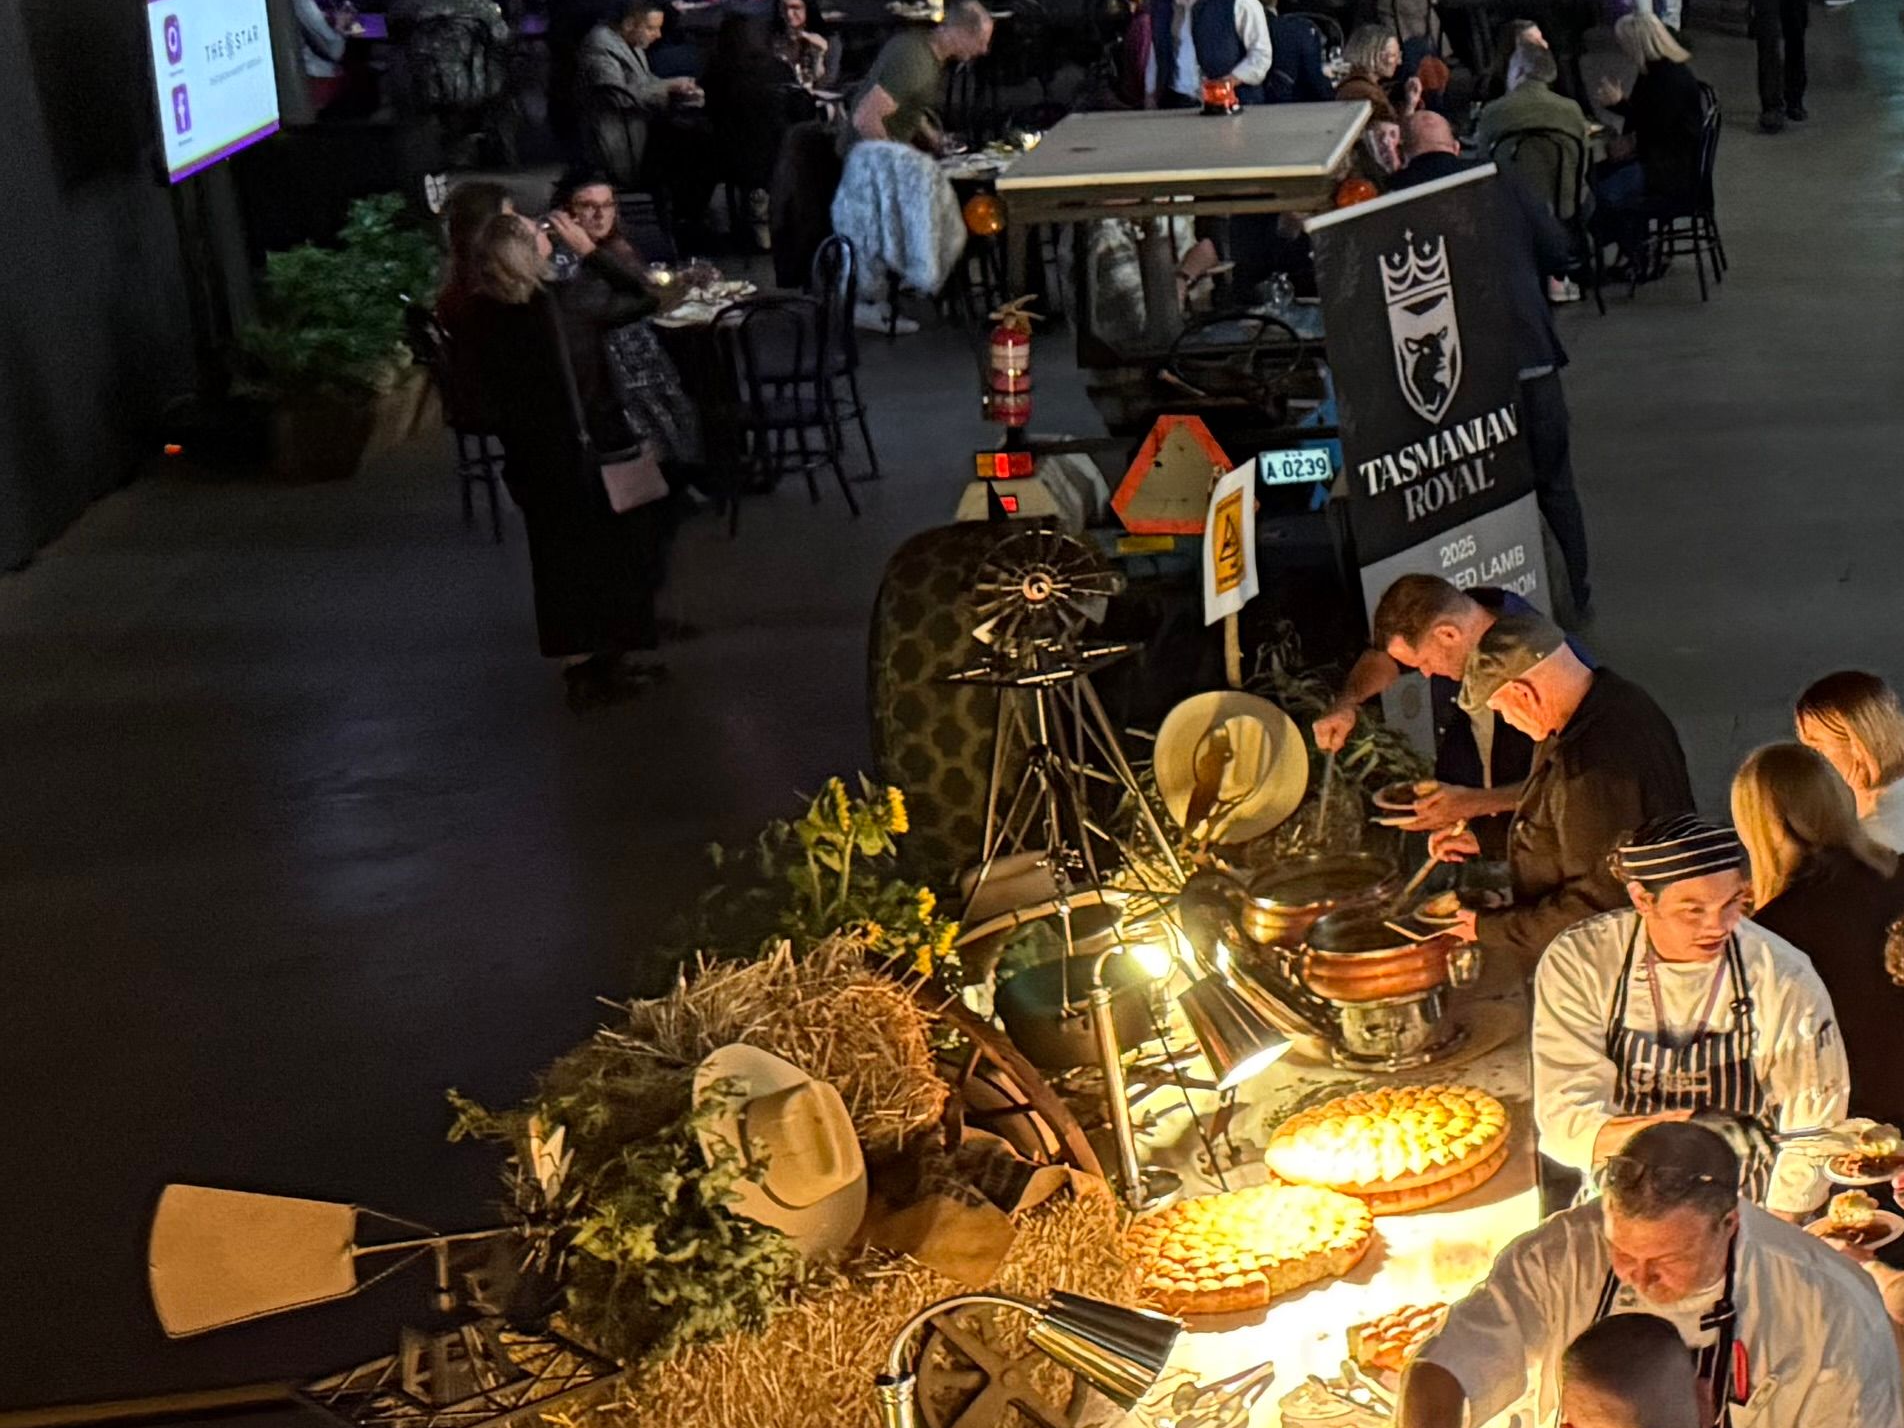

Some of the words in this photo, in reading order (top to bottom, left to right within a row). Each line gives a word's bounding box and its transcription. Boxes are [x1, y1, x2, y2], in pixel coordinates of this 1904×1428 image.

[234, 25, 259, 50] STAR
[1358, 404, 1518, 497] TASMANIAN
[1403, 457, 1496, 522] ROYAL
[1439, 535, 1477, 567] 2025
[1480, 545, 1526, 582] LAMB
